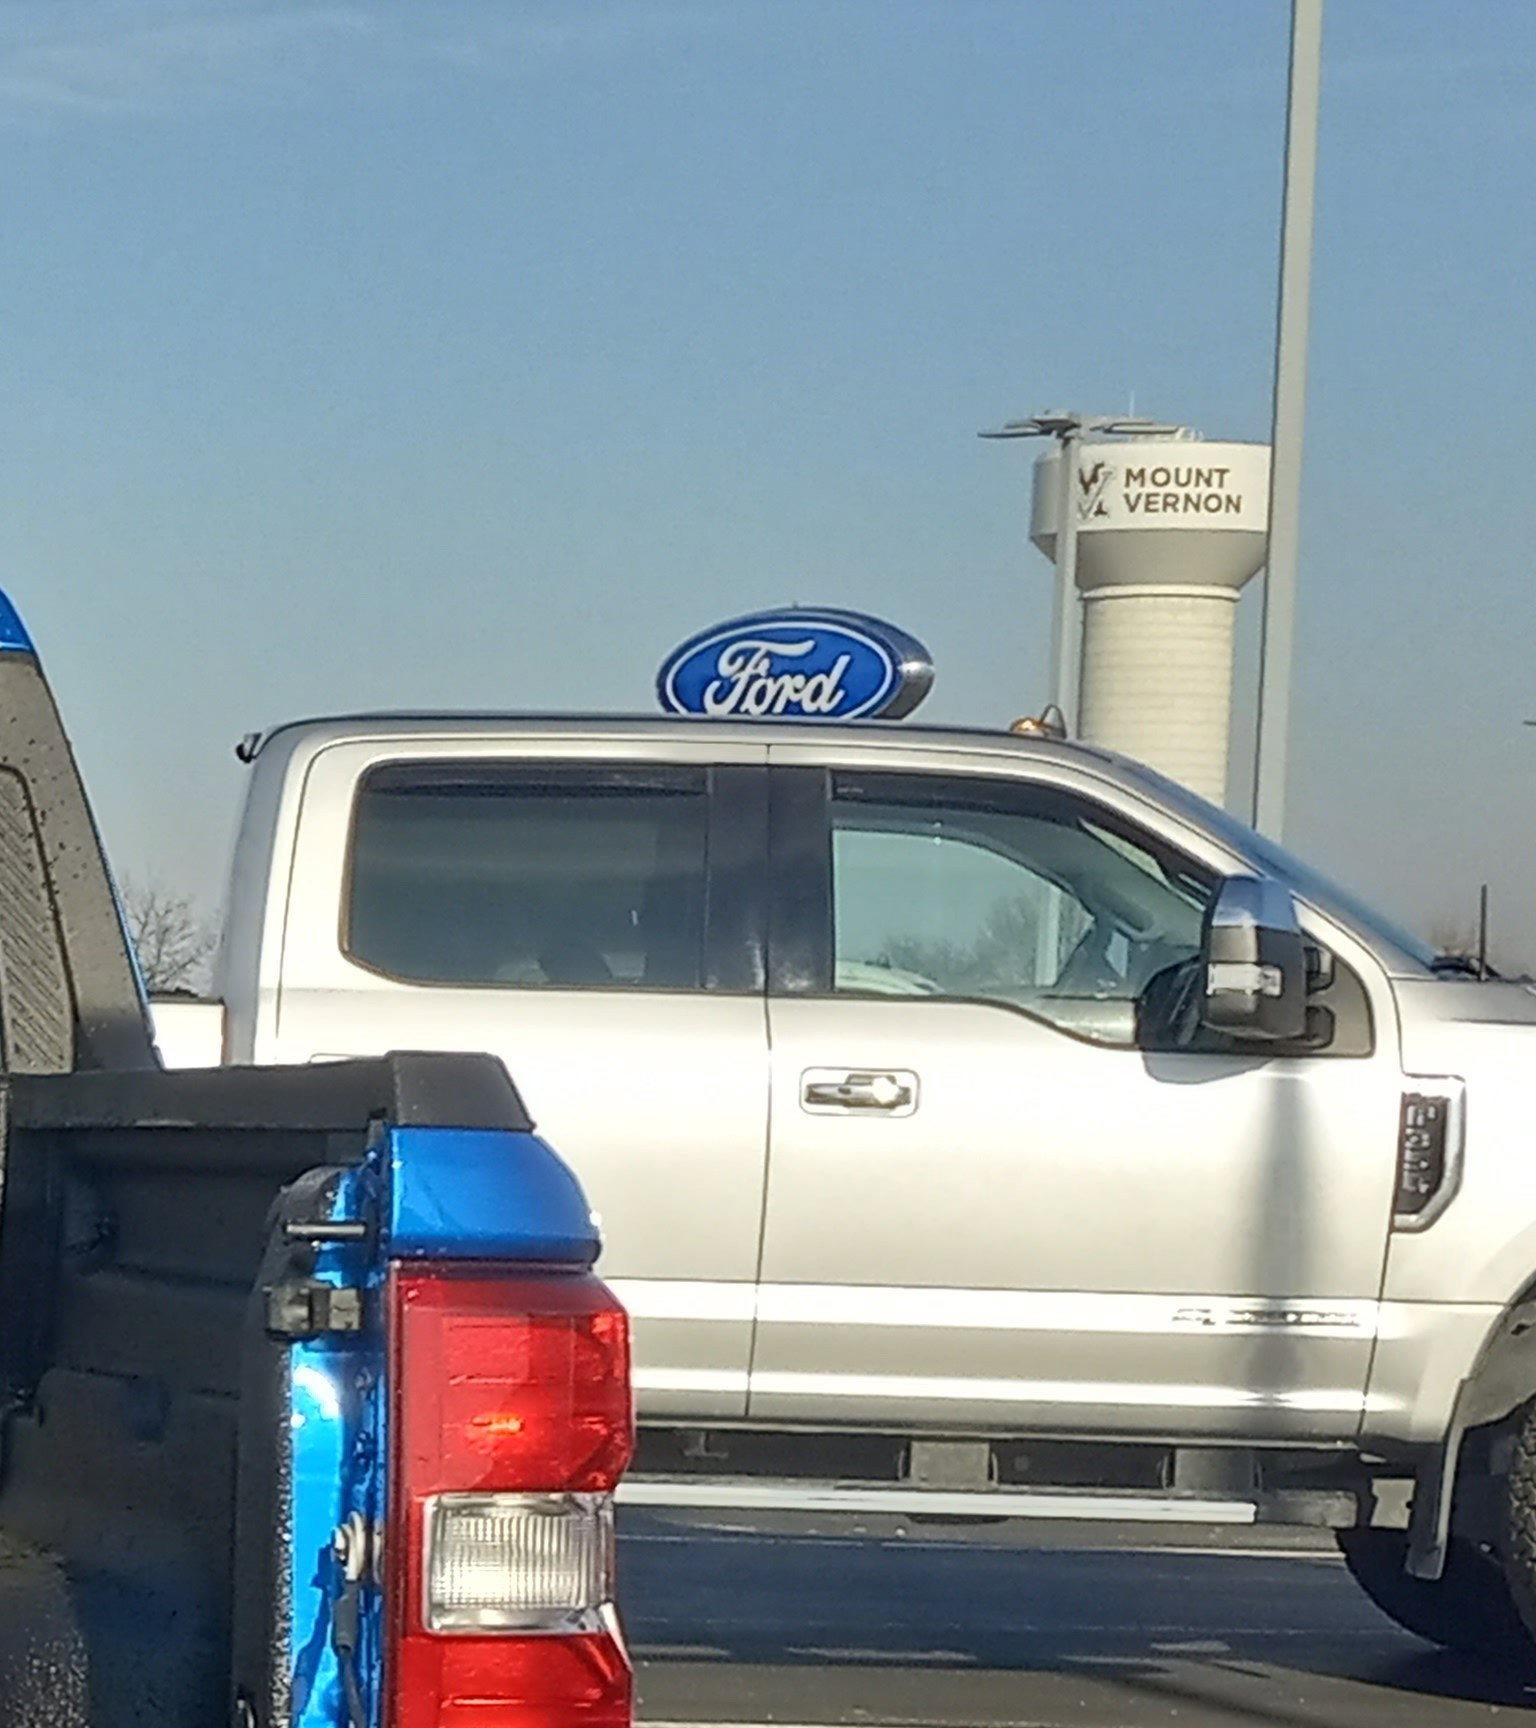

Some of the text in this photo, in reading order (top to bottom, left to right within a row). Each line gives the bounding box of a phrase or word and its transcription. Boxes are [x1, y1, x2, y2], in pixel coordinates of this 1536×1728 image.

[1123, 466, 1231, 489] MOUNT
[1122, 492, 1243, 515] VERNON
[703, 638, 852, 716] Ford
